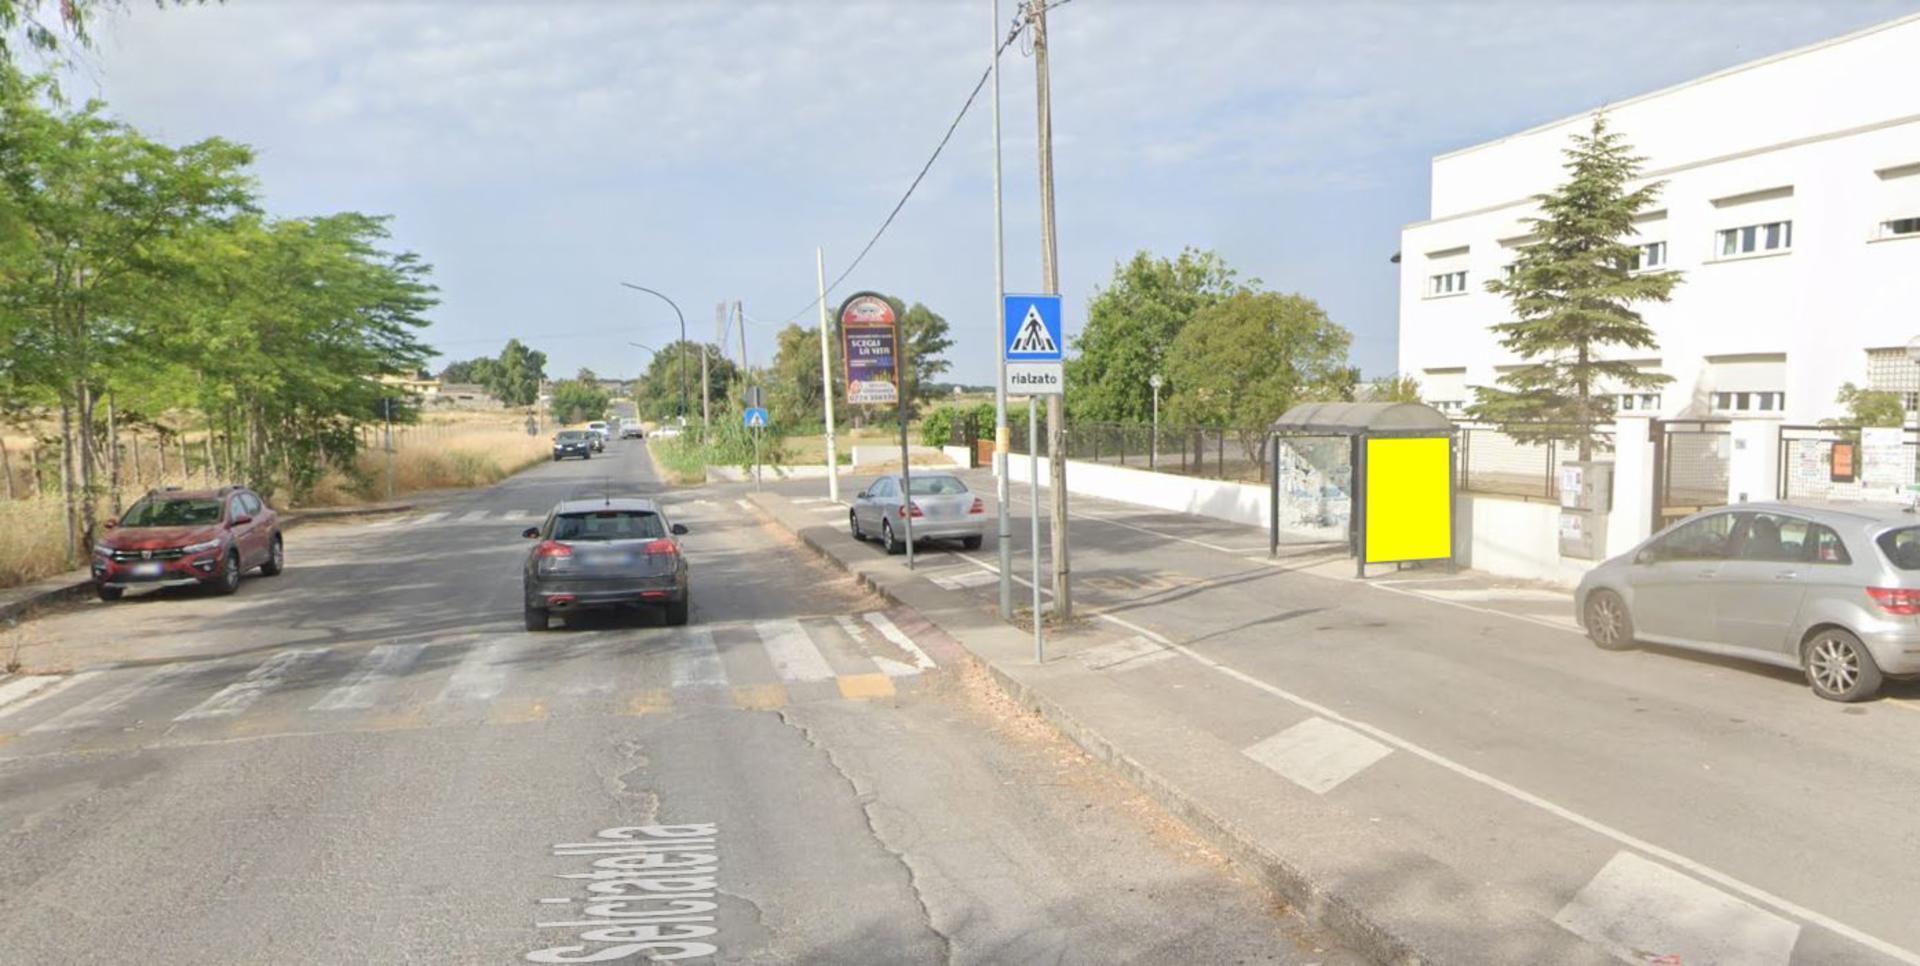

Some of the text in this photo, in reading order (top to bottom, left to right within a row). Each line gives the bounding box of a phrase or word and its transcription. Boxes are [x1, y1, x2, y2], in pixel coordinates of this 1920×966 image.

[851, 339, 881, 347] SCEGLI
[859, 347, 890, 355] LA VITA
[1011, 372, 1056, 384] rialzato
